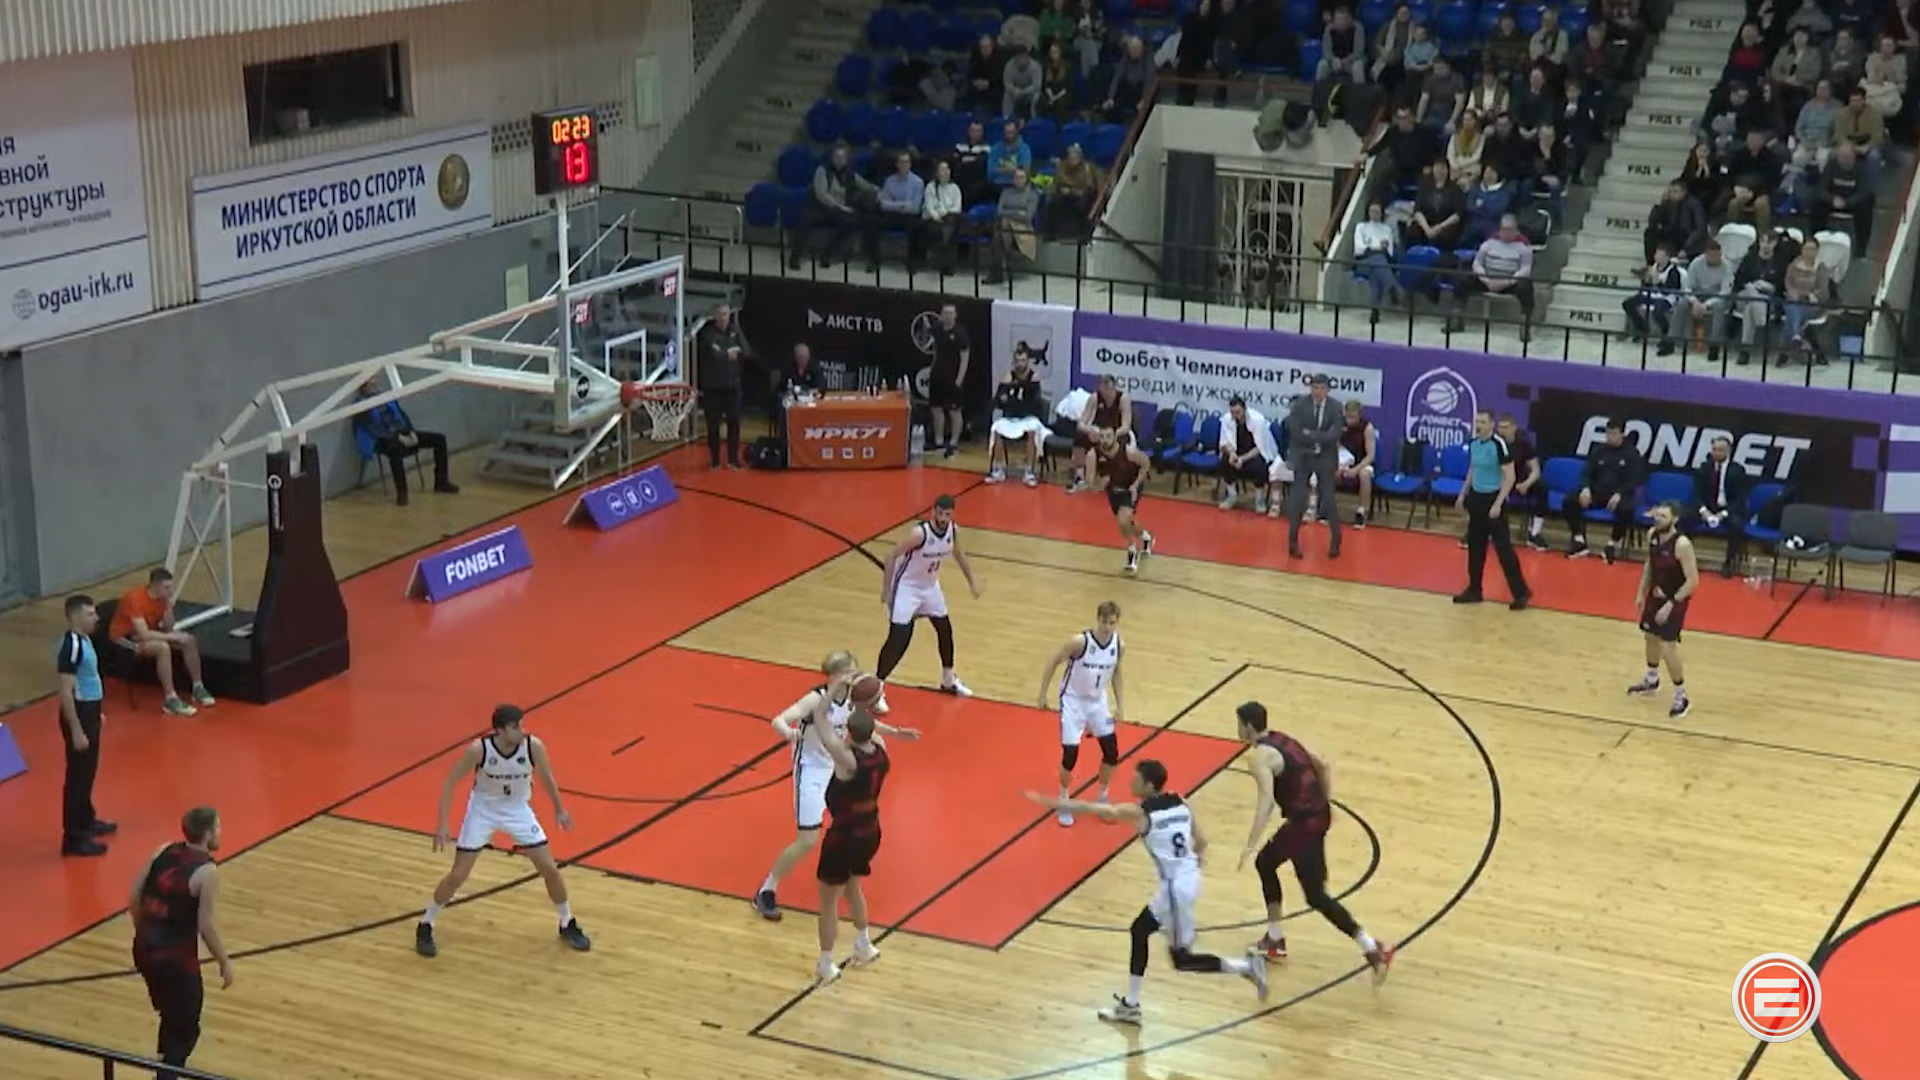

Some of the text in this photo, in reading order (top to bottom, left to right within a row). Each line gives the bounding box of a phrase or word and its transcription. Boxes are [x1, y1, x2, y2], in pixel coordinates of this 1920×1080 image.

[565, 142, 588, 182] 13
[222, 164, 426, 231] МИНИСТЕРСТВО СПОРТА
[236, 195, 416, 259] ИРКУТСКОЙ ОБЛАСТИ
[38, 271, 134, 314] ogau-irk.ru
[826, 313, 883, 334] АИСТ ТВ
[1096, 347, 1366, 393] Фонбет Чемпионат Росии
[1182, 383, 1264, 404] мужских
[803, 426, 892, 440] ИРКУТ
[445, 543, 506, 585] FONBET
[1172, 832, 1187, 858] 8
